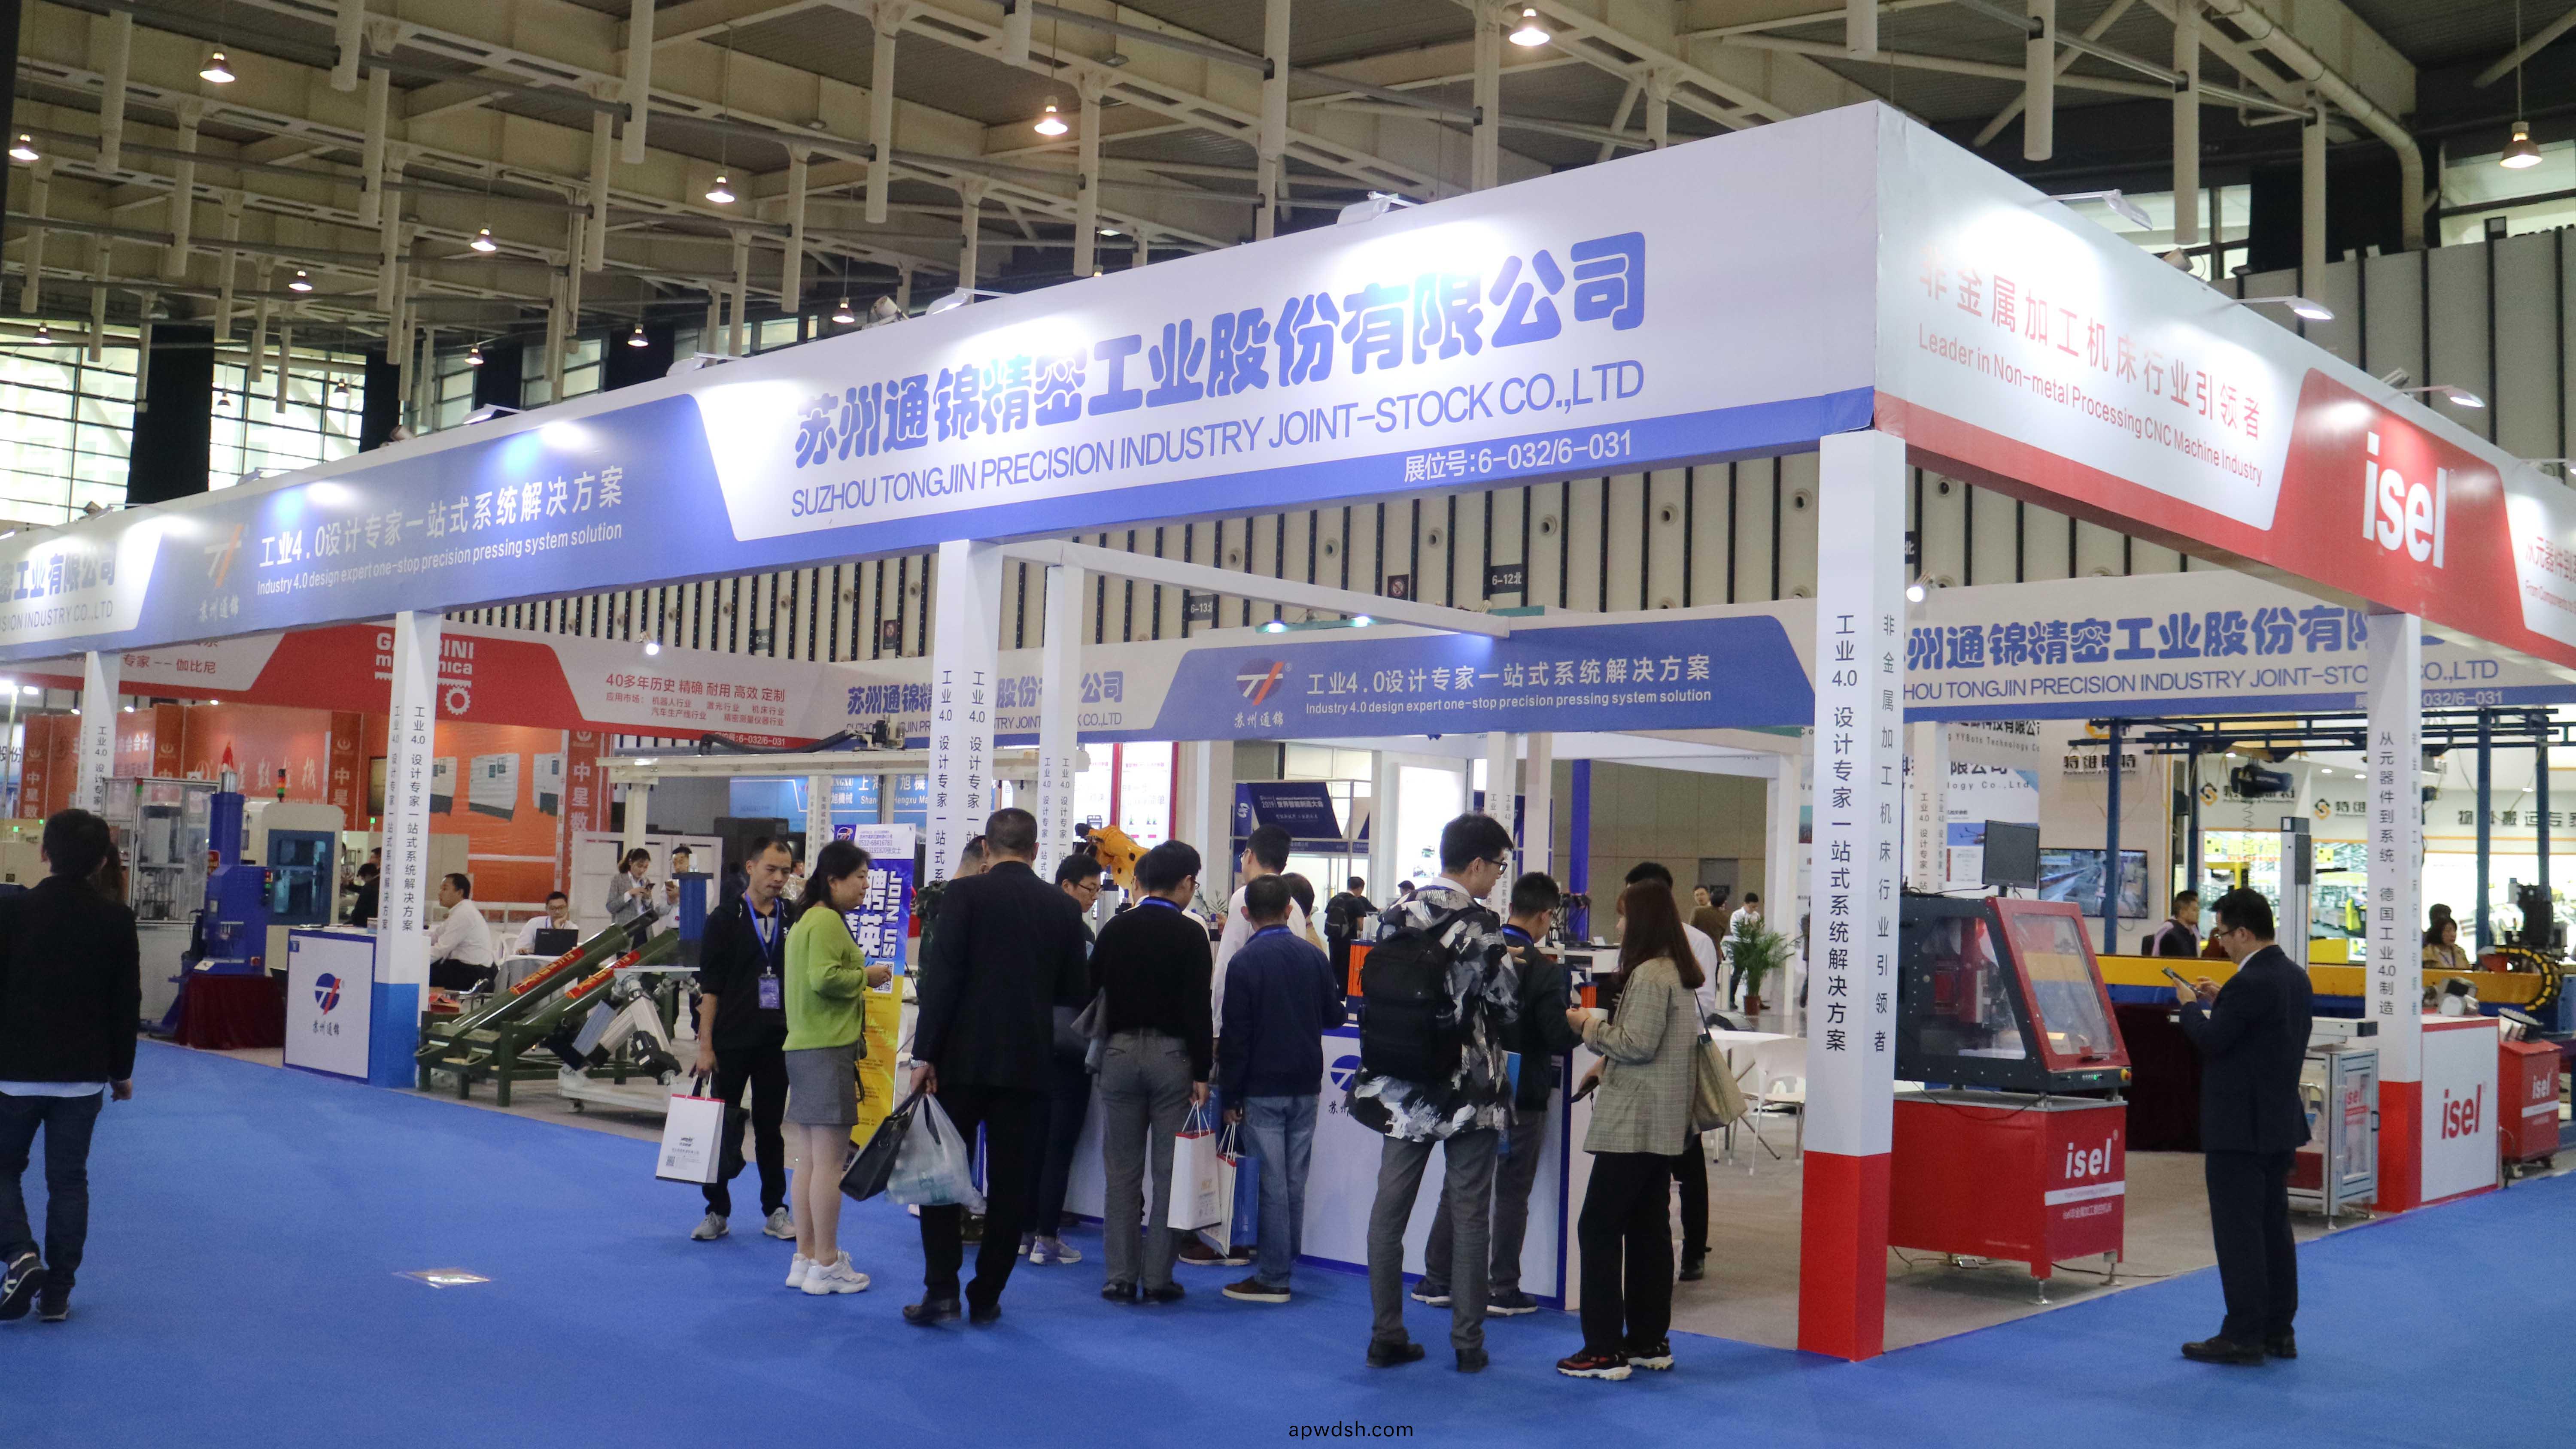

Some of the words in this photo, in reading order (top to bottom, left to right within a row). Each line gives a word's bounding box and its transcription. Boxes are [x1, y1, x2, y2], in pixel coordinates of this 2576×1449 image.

[796, 231, 1645, 469] 苏州通锦精密工业股份有限公司
[1919, 245, 2260, 441] 非金属加工机床行业引领者
[1919, 322, 1974, 368] Leader
[1977, 346, 1990, 375] in
[1994, 356, 2069, 405] Non-metal
[2072, 386, 2142, 440] Processing
[2145, 416, 2172, 447] CNC
[2174, 431, 2219, 467] Machine
[2222, 448, 2263, 487] Industry
[792, 483, 876, 516] SUZHOU
[881, 463, 975, 503] TONGJIN
[981, 440, 1115, 488] PRECISION
[1121, 417, 1264, 468] INDUSTRY
[1268, 381, 1494, 447] JOINT-STOCK
[1499, 360, 1644, 416] CO.,LTD
[1404, 430, 1631, 483] 展位号:6-032/6-031
[2363, 431, 2447, 569] isel
[258, 578, 293, 596] Industry
[293, 572, 307, 589] 4.0
[309, 568, 339, 587] design
[341, 562, 372, 584] expert
[374, 557, 419, 576] one-stop
[422, 547, 471, 569] precision
[473, 538, 522, 565] pressing
[525, 532, 568, 555] system
[571, 522, 621, 546] solution
[25, 606, 72, 628] INDUSTRY
[606, 673, 675, 692] 40多年历史
[706, 682, 730, 698] 耐用
[734, 685, 758, 700] 高效
[761, 687, 785, 703] 定制
[1306, 702, 1348, 715] Industry
[1350, 701, 1367, 713] 4.0
[1369, 701, 1404, 715] design
[1406, 700, 1441, 715] expert
[1444, 697, 1497, 713] one-stop
[1499, 695, 1553, 710] precision
[1556, 693, 1609, 707] pressing
[1612, 691, 1657, 706] system
[1660, 689, 1711, 702] solution
[1946, 679, 2026, 699] TONGJIN
[2031, 674, 2136, 695] PRECISION
[2141, 669, 2247, 692] INDUSTRY
[1874, 614, 1895, 1052] 非金属加工机床行业引领者
[885, 871, 902, 924] JOIN
[882, 928, 897, 958] US
[2441, 1084, 2482, 1140] isel
[2533, 1072, 2551, 1099] isel
[2065, 1138, 2112, 1179] isel
